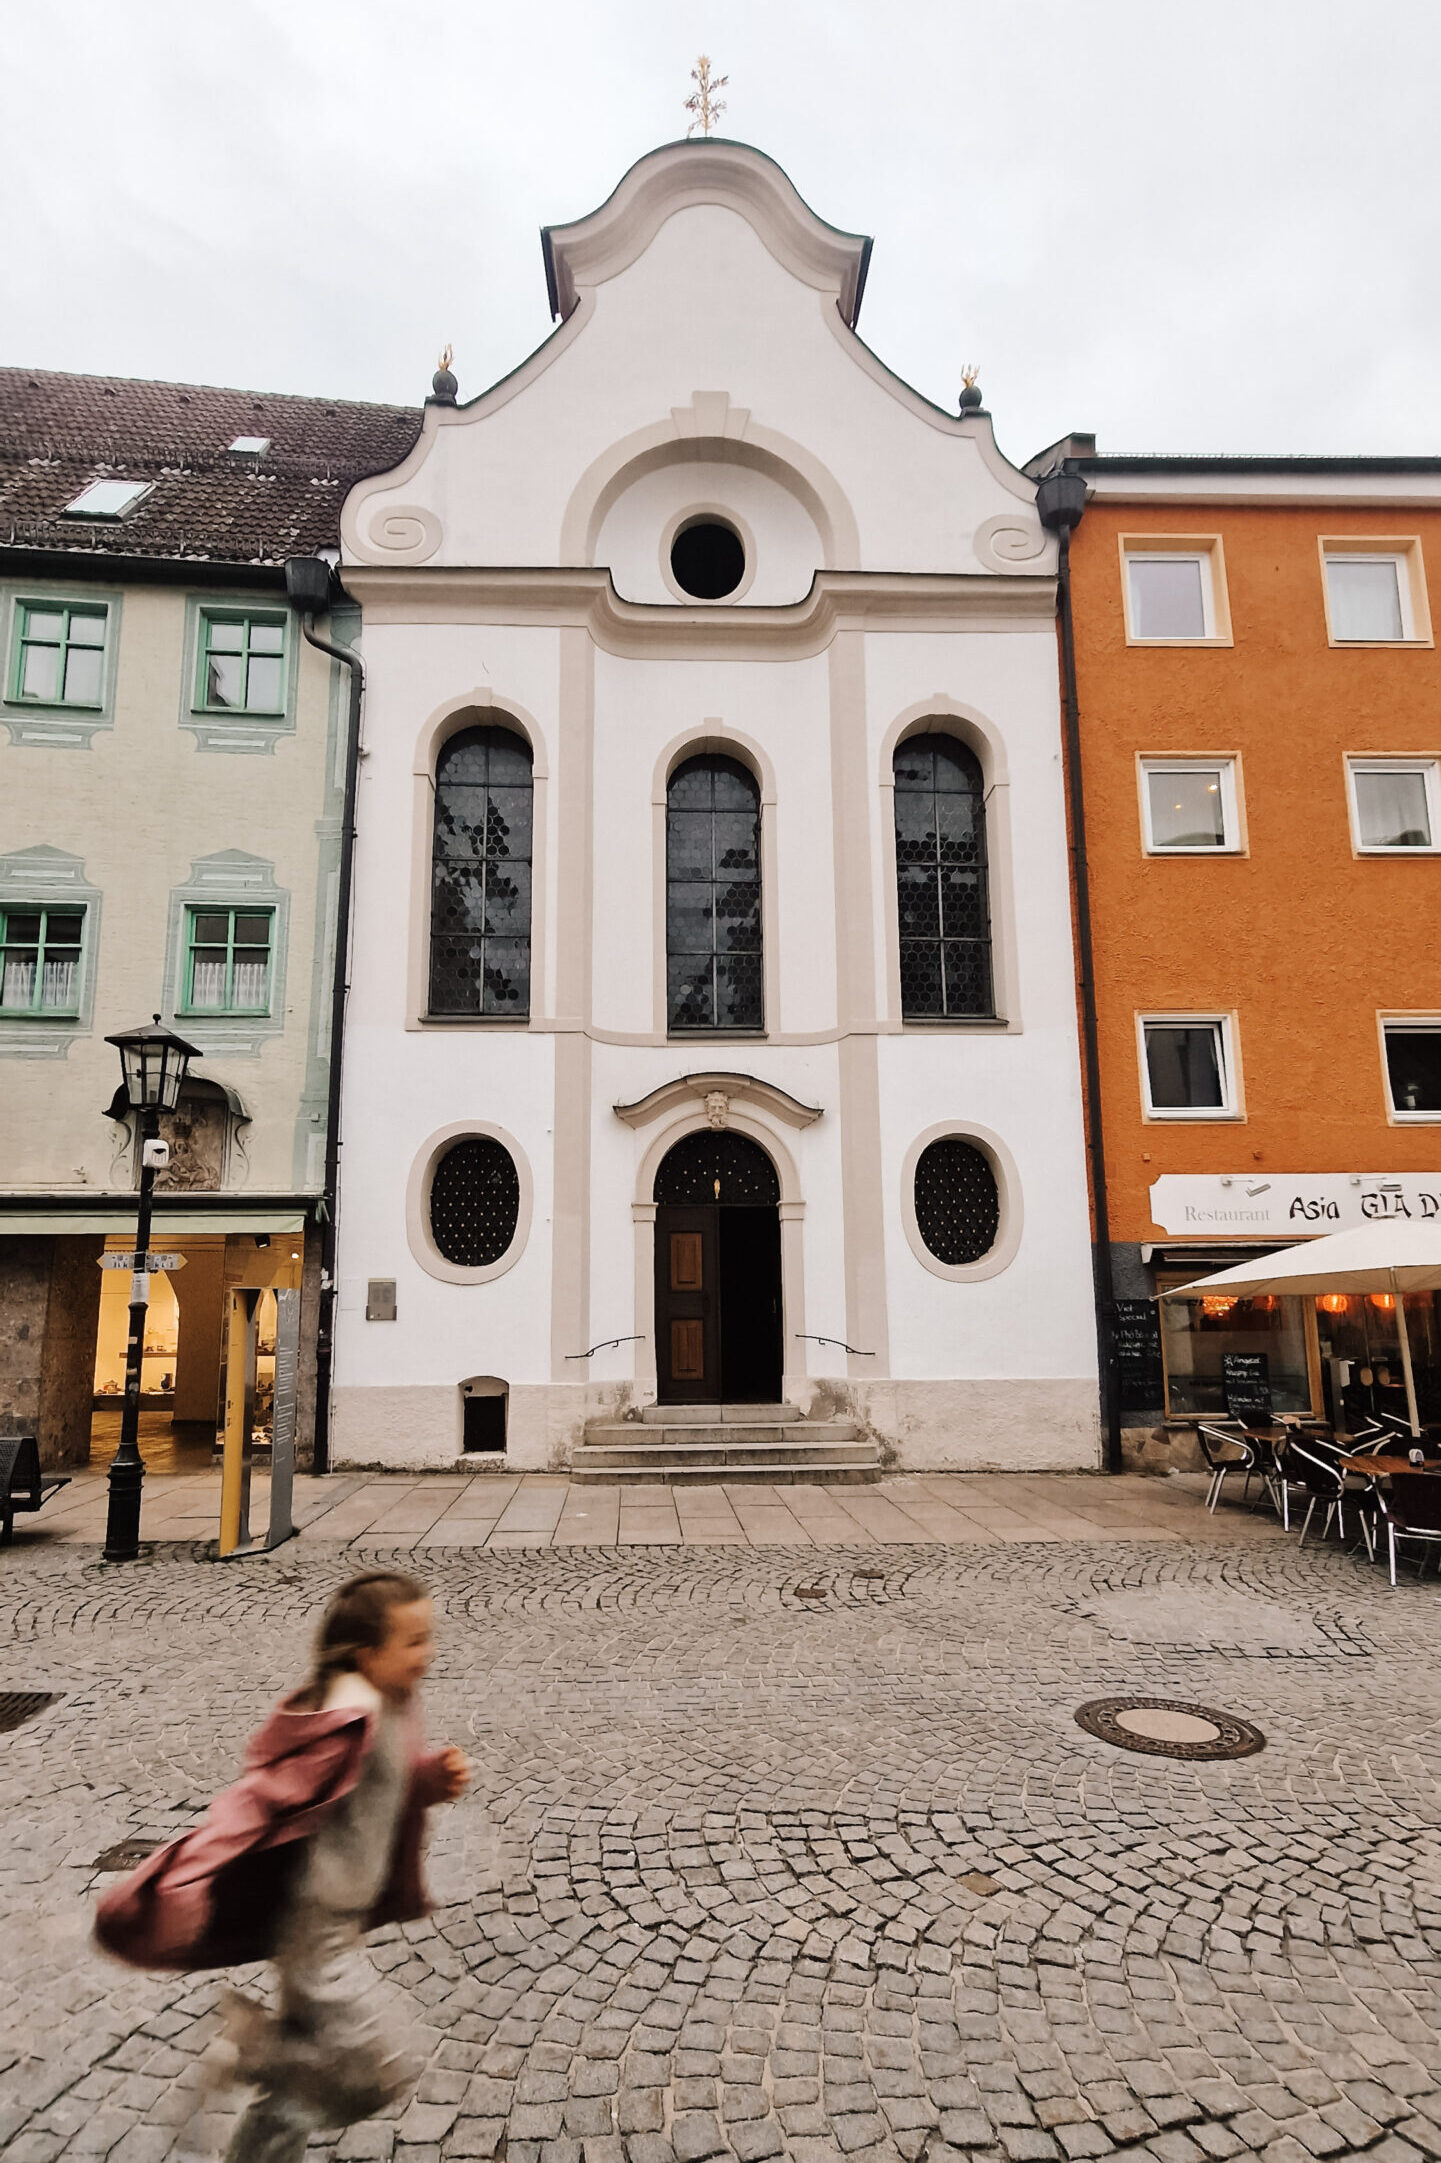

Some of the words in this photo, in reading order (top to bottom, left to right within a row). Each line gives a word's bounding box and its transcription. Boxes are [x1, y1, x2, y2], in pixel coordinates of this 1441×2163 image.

[1184, 1205, 1271, 1221] Restaurant
[1289, 1196, 1340, 1221] Asia
[1418, 1192, 1441, 1218] D
